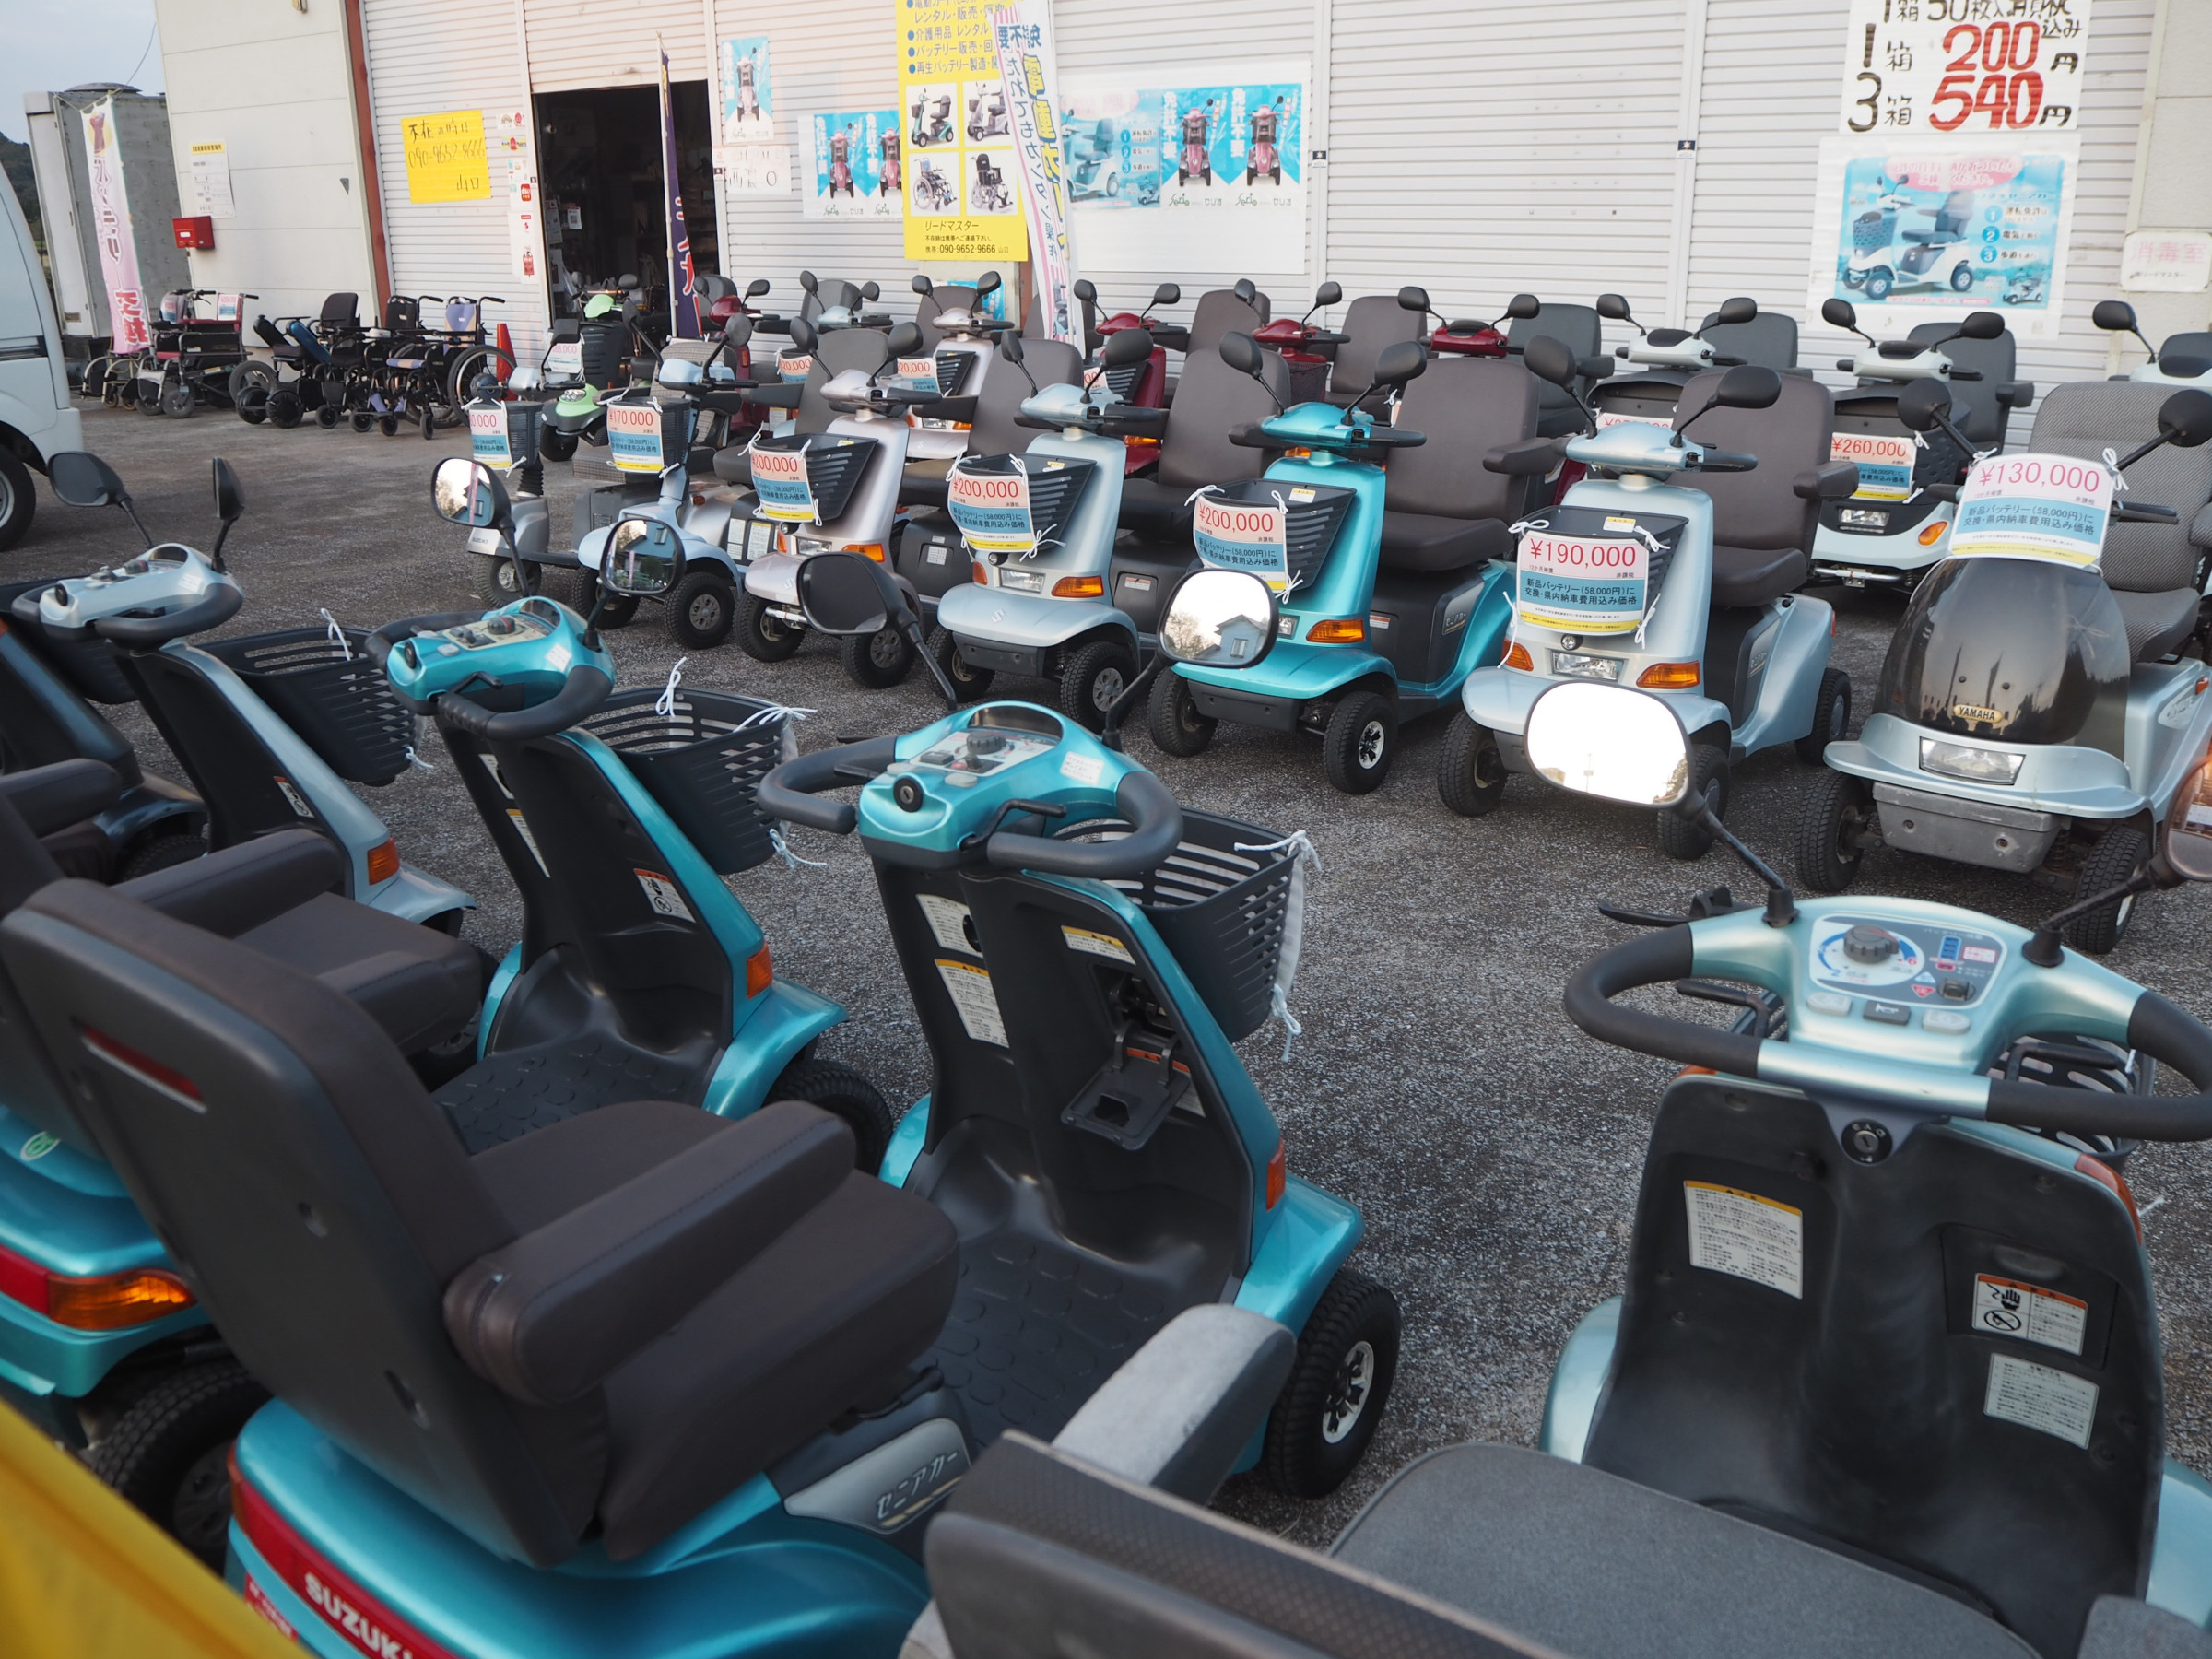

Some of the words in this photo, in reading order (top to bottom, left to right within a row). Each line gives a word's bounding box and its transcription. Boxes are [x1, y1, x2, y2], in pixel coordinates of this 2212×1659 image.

[916, 40, 994, 56] バッテリー販売・回
[916, 56, 1000, 75] 再生バッテリー製造・開
[1163, 91, 1178, 159] 免許不要
[1231, 88, 1246, 158] 免許不要
[924, 220, 980, 231] リードマスター
[2130, 241, 2207, 264] 消毒室
[1831, 437, 1907, 457] ¥260,000
[953, 477, 1018, 500] ¥200,000
[1979, 462, 2100, 492] ¥130,000
[1199, 503, 1274, 534] ¥200,000
[1530, 537, 1636, 569] ¥190,000
[1959, 706, 1995, 721] YAMAHA
[877, 1451, 959, 1520] セニアカー
